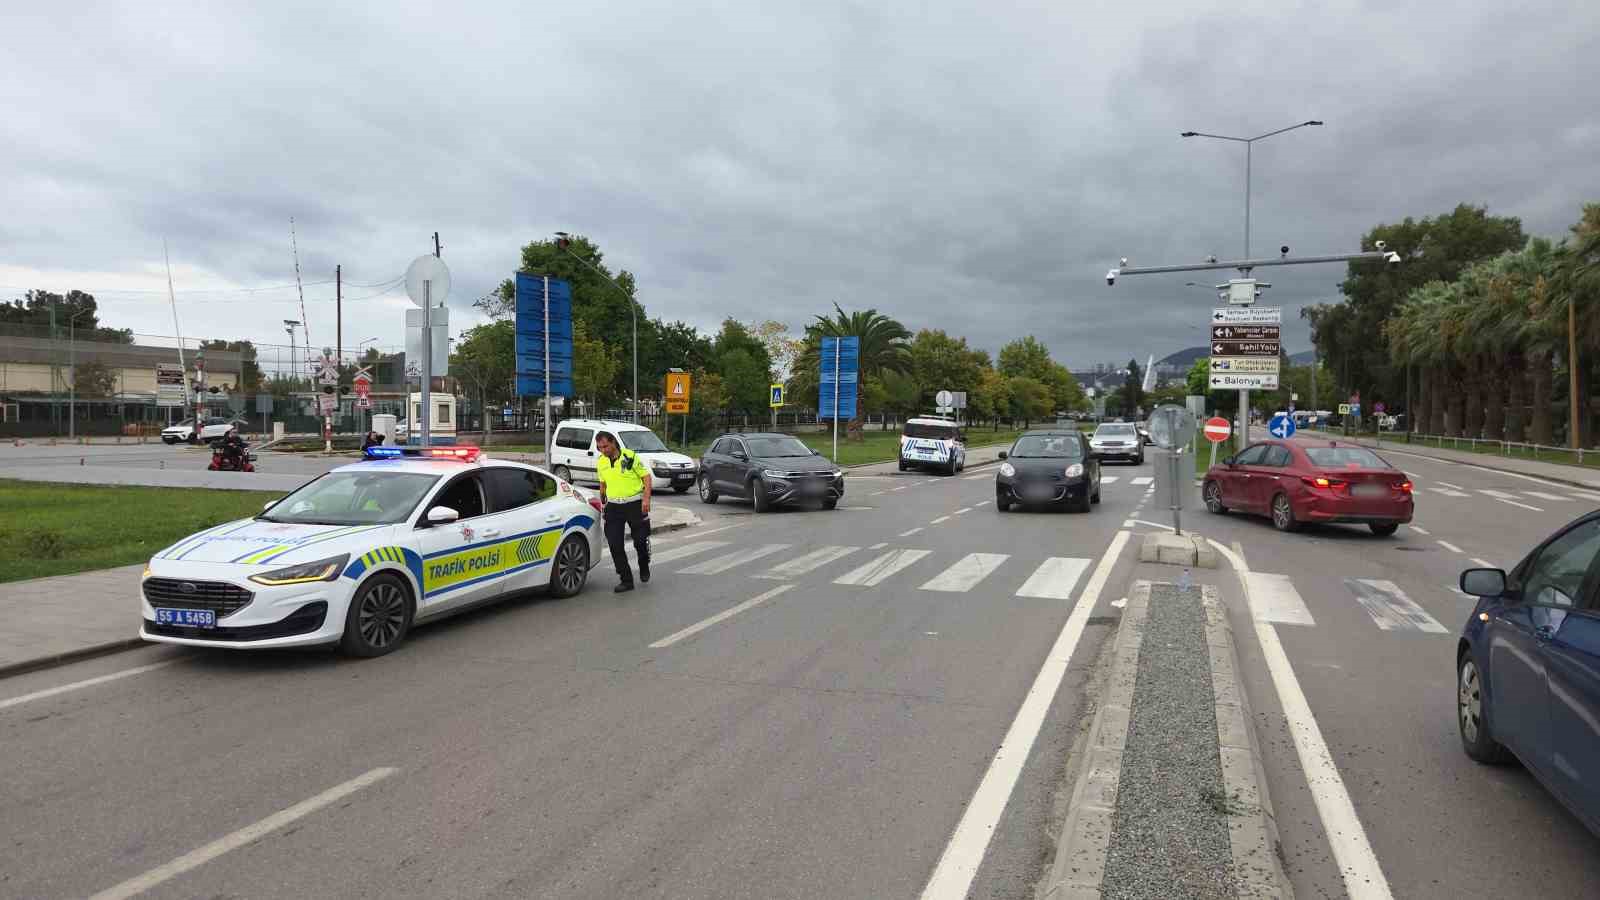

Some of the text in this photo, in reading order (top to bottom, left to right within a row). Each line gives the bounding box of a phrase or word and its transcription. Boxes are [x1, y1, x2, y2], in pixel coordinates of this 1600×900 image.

[1240, 343, 1277, 351] Sahil Yolu
[1224, 376, 1261, 386] Balonya
[429, 549, 500, 580] TRAFİK POLİSİ
[159, 610, 173, 622] 55
[176, 611, 183, 622] A
